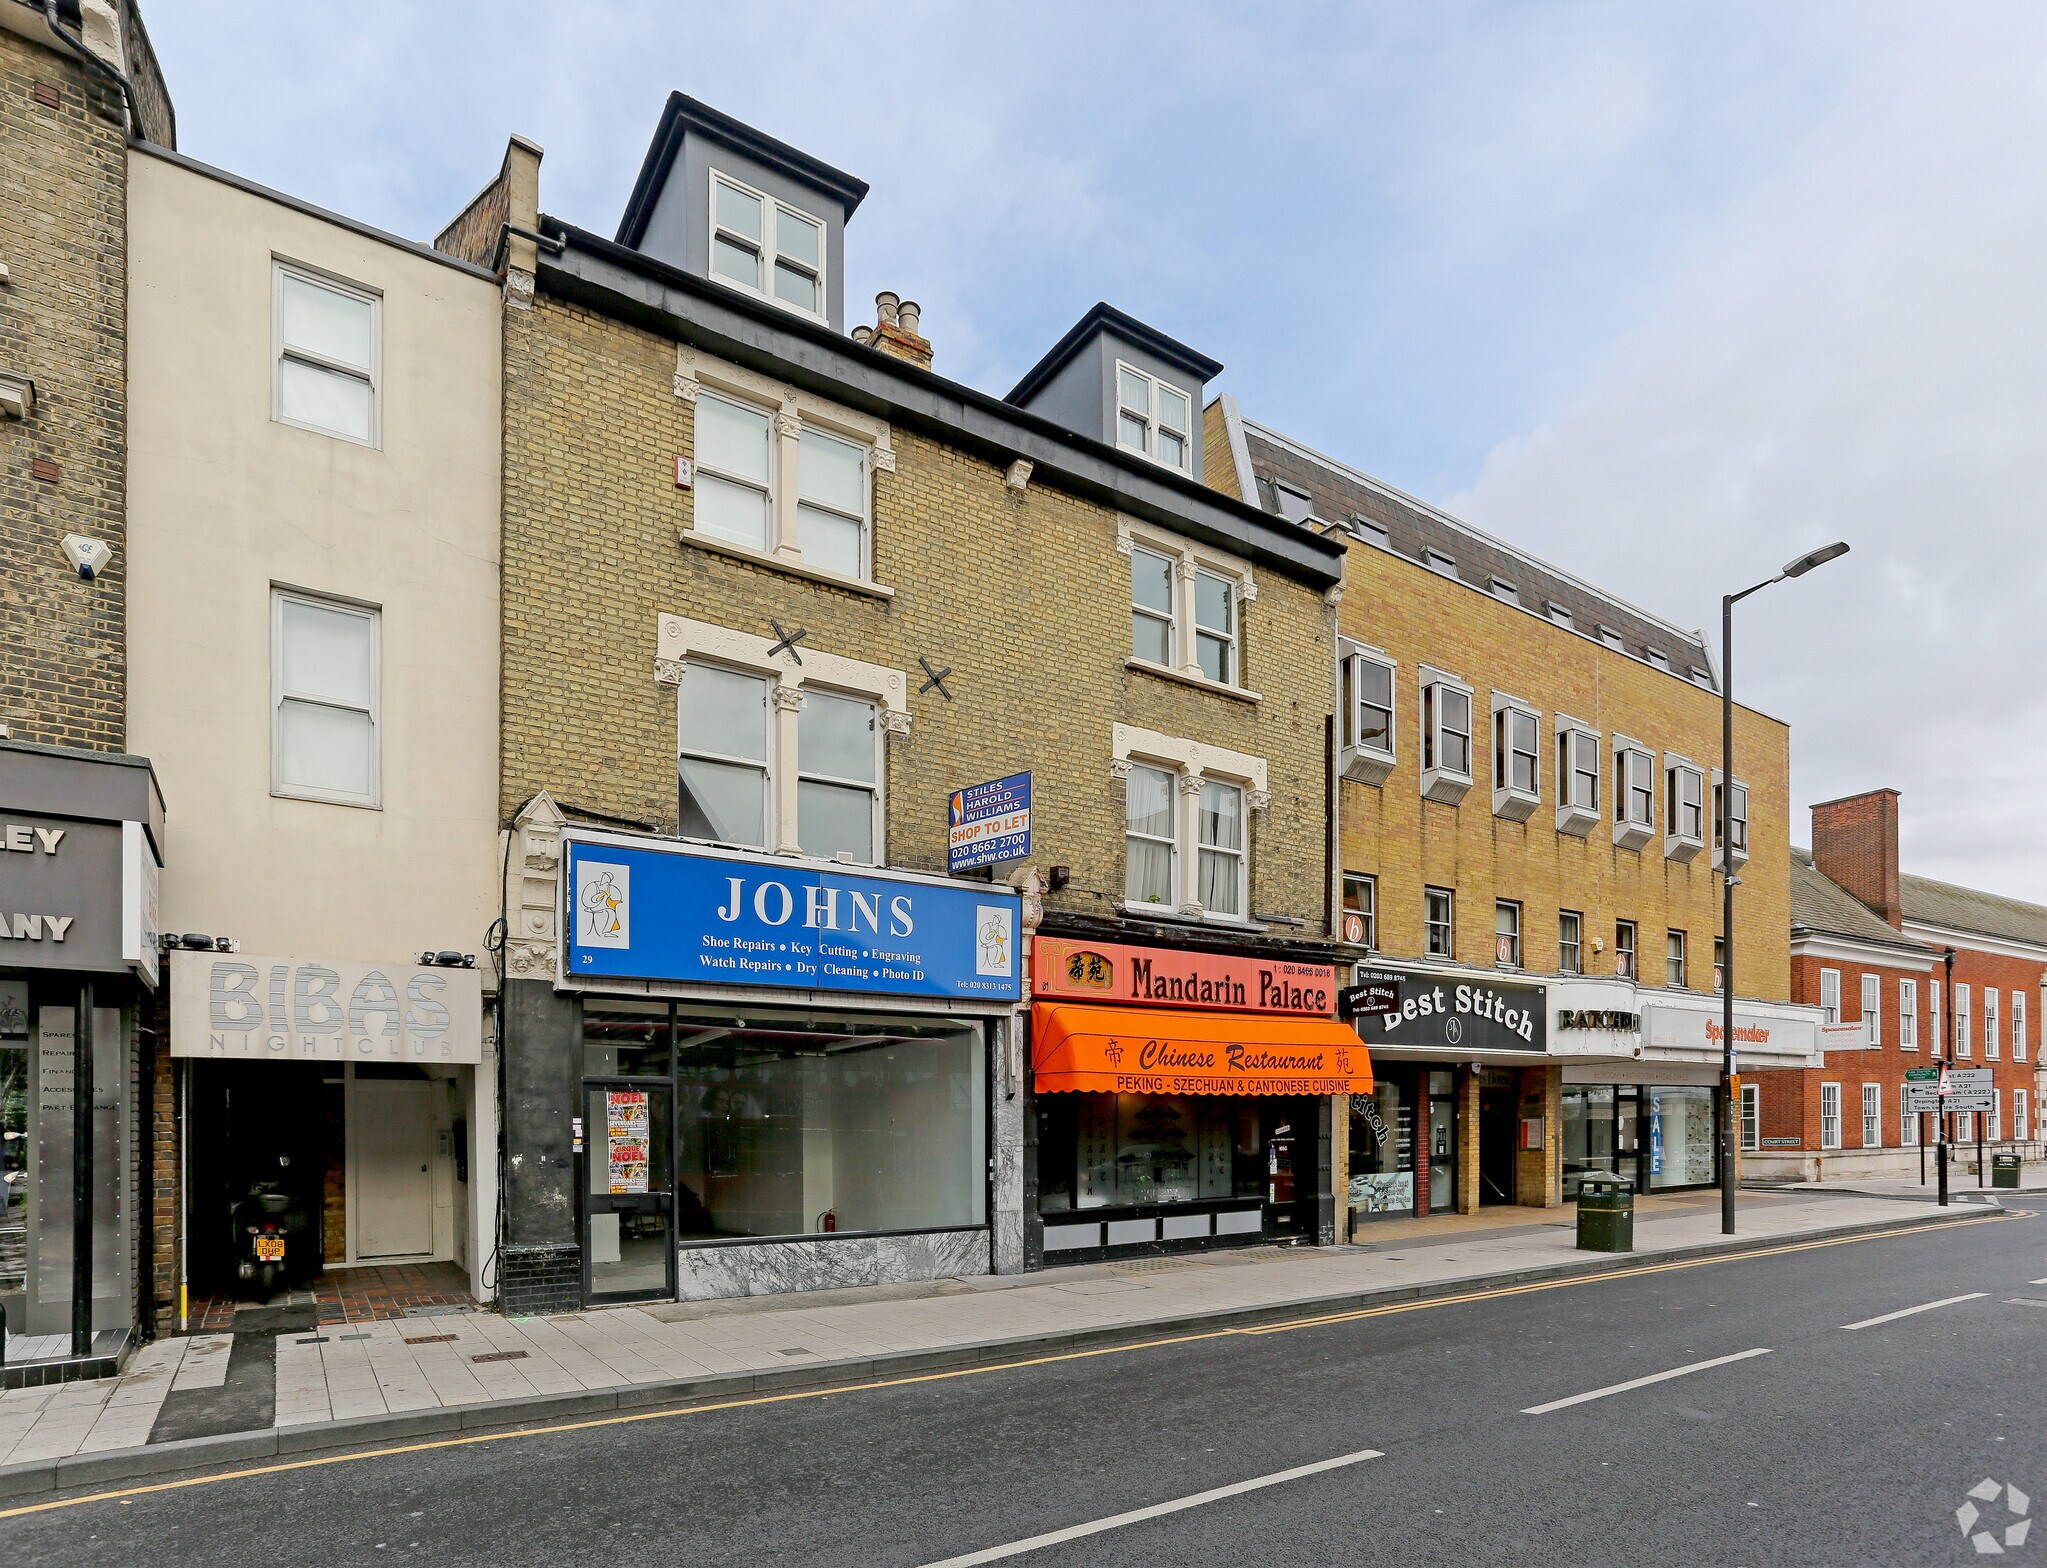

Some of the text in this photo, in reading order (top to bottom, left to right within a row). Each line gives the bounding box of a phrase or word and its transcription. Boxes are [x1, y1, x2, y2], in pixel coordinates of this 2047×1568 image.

[966, 781, 1003, 799] STILES
[966, 791, 1012, 810] HAROLD
[966, 800, 1020, 821] WILLIAMS
[951, 814, 1028, 844] SHOP TO LET
[951, 845, 1026, 870] www.shw.co.uk
[952, 833, 1025, 858] 020 8662 2700
[717, 877, 914, 938] JOHNS
[582, 955, 593, 964] 29
[702, 935, 921, 965] Shoe Repairs Key Cutting Engraving
[699, 955, 925, 981] Watch Repairs Dry Cleaning Photo ID
[1283, 965, 1296, 975] 020
[957, 980, 1012, 991] Tel: 020 8313 1475
[1131, 957, 1327, 1011] Mandarin Palace
[1350, 987, 1395, 1003] Best Stitch
[209, 961, 450, 1039] BIBAS
[1455, 984, 1534, 1043] Stitch
[1705, 1018, 1770, 1046] Spaemaker
[210, 1034, 450, 1057] NIGHTCLUB
[1139, 1040, 1324, 1072] Chinese Restaurant
[1117, 1076, 1163, 1091] PEKING
[1173, 1079, 1235, 1092] SZECHUAN
[1237, 1080, 1245, 1092] &
[1249, 1080, 1310, 1092] CANTONESE
[1312, 1080, 1350, 1092] CUISINE
[611, 1093, 645, 1105] NOEL
[1652, 1096, 1661, 1172] SALE
[612, 1151, 646, 1163] NOEL
